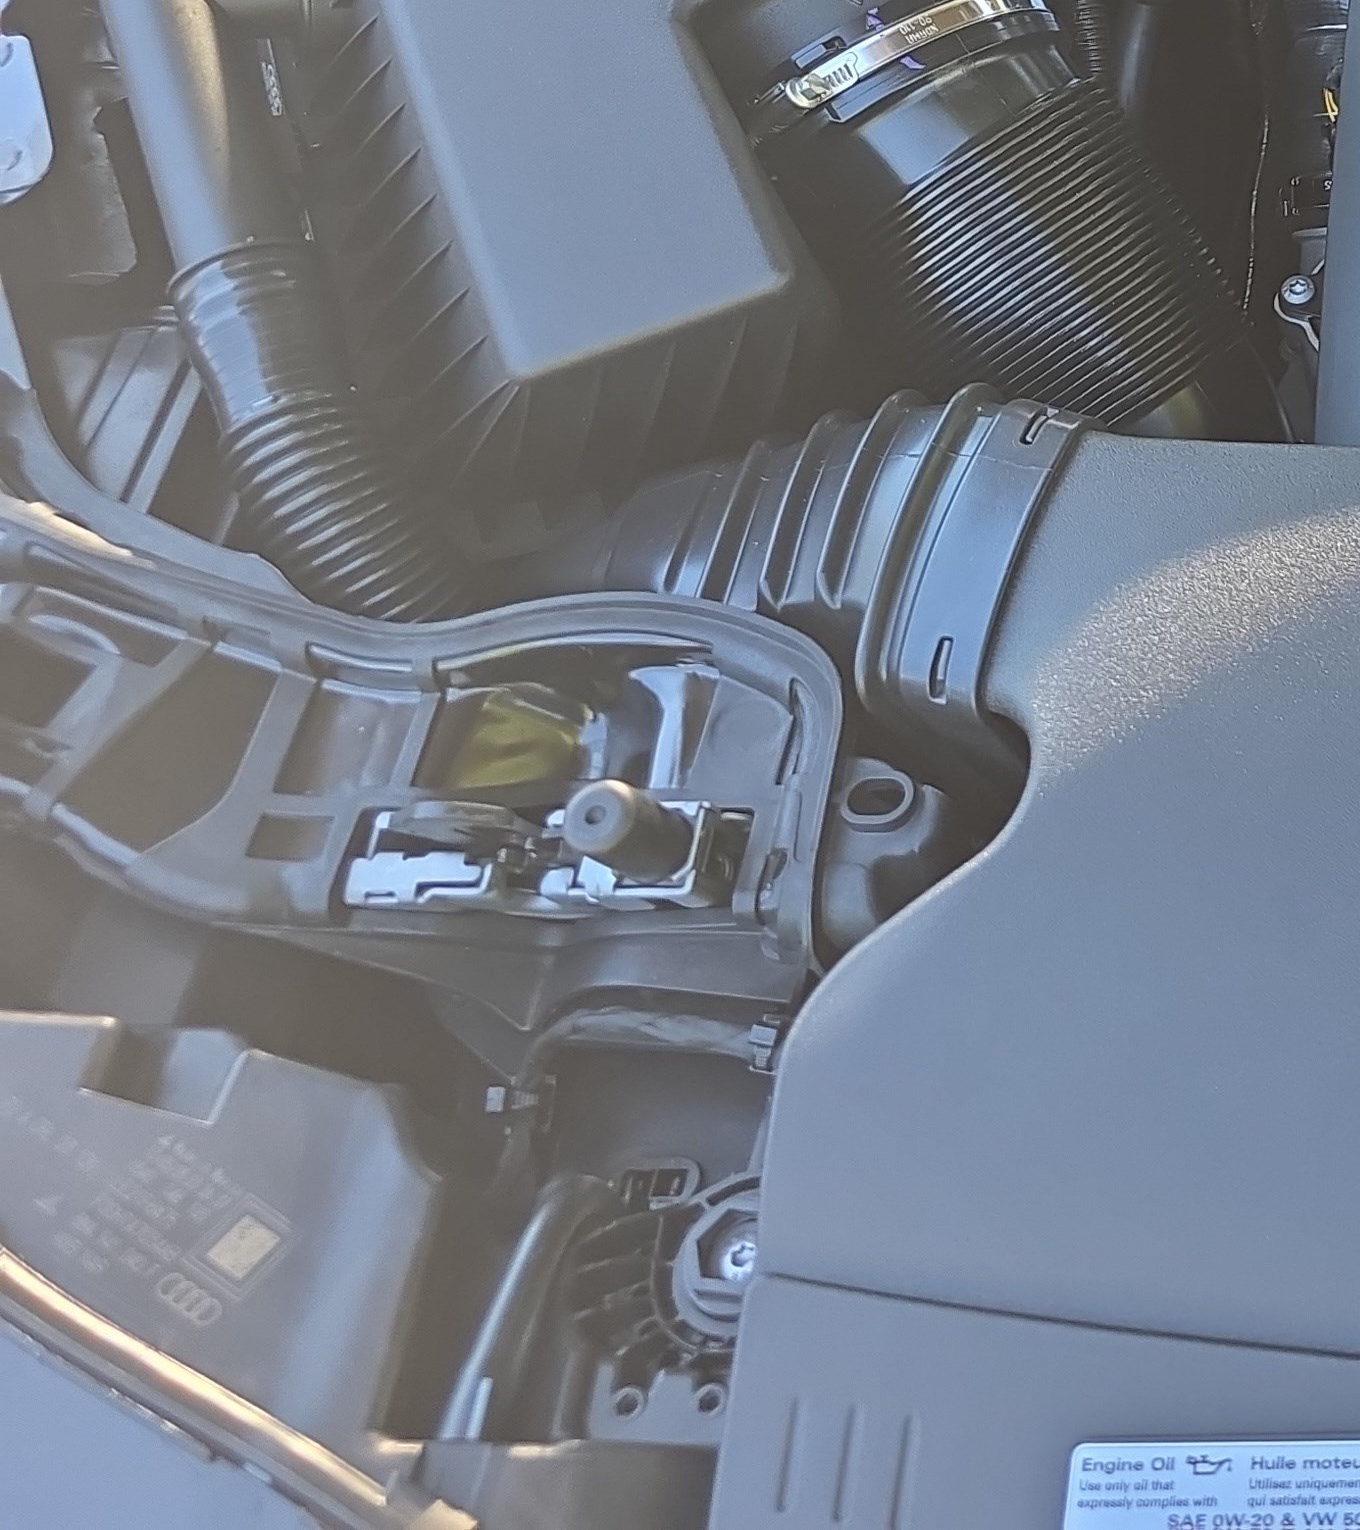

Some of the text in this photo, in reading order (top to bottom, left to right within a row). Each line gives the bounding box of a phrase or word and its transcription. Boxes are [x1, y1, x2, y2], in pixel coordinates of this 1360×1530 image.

[1081, 1456, 1175, 1475] Engine Oil
[1250, 1455, 1297, 1470] Huile
[1078, 1479, 1102, 1491] Use
[1105, 1478, 1130, 1494] only
[1151, 1478, 1175, 1491] that
[1193, 1494, 1218, 1507] with
[1167, 1513, 1207, 1527] SAE
[1212, 1512, 1274, 1527] 0W-20
[1281, 1511, 1296, 1526] &
[1301, 1511, 1338, 1526] VW
